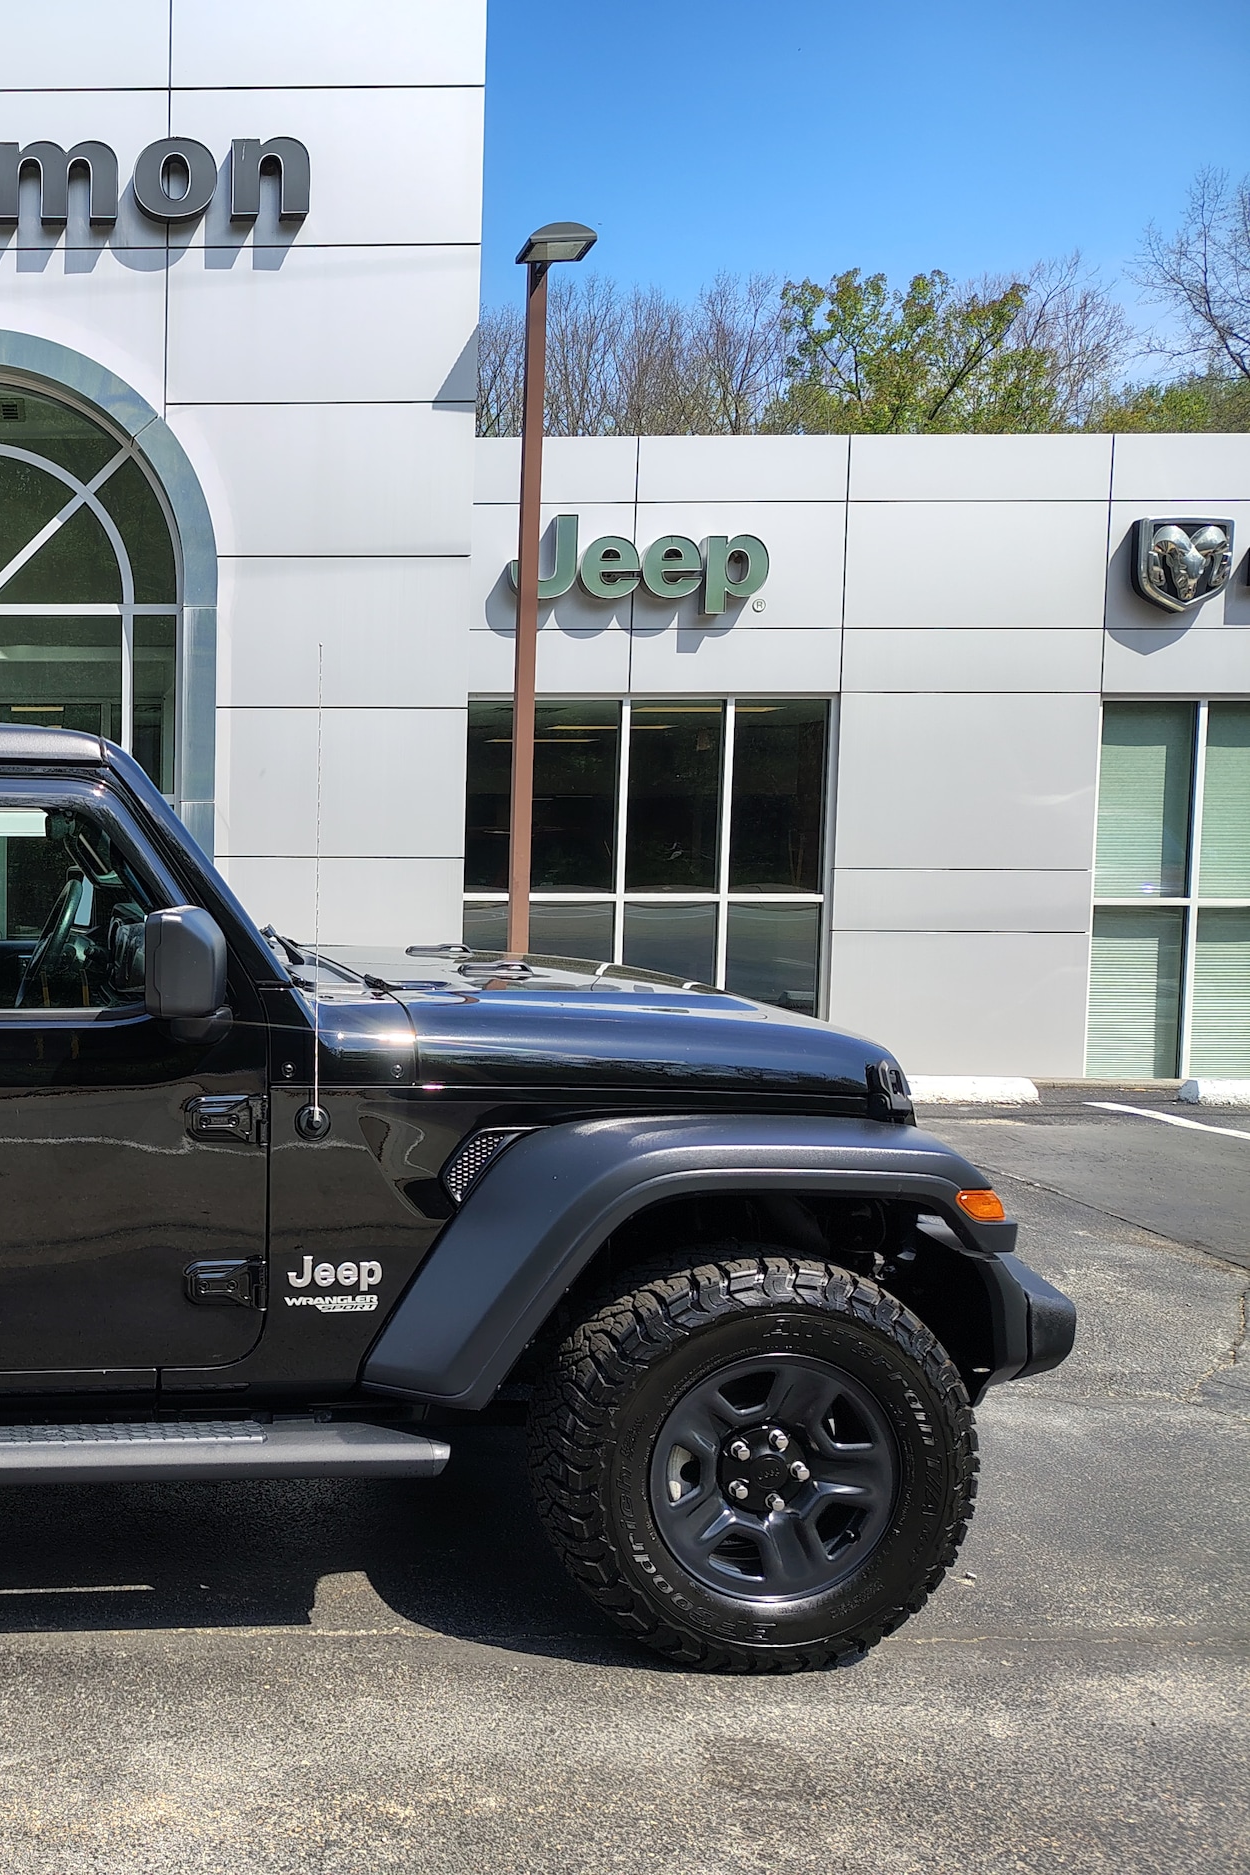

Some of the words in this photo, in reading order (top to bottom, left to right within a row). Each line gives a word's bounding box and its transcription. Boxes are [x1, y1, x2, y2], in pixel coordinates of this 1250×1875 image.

[509, 513, 770, 615] Jeep
[287, 1255, 382, 1292] Jeep
[284, 1294, 378, 1307] WRANGLER
[321, 1303, 375, 1312] SPORT
